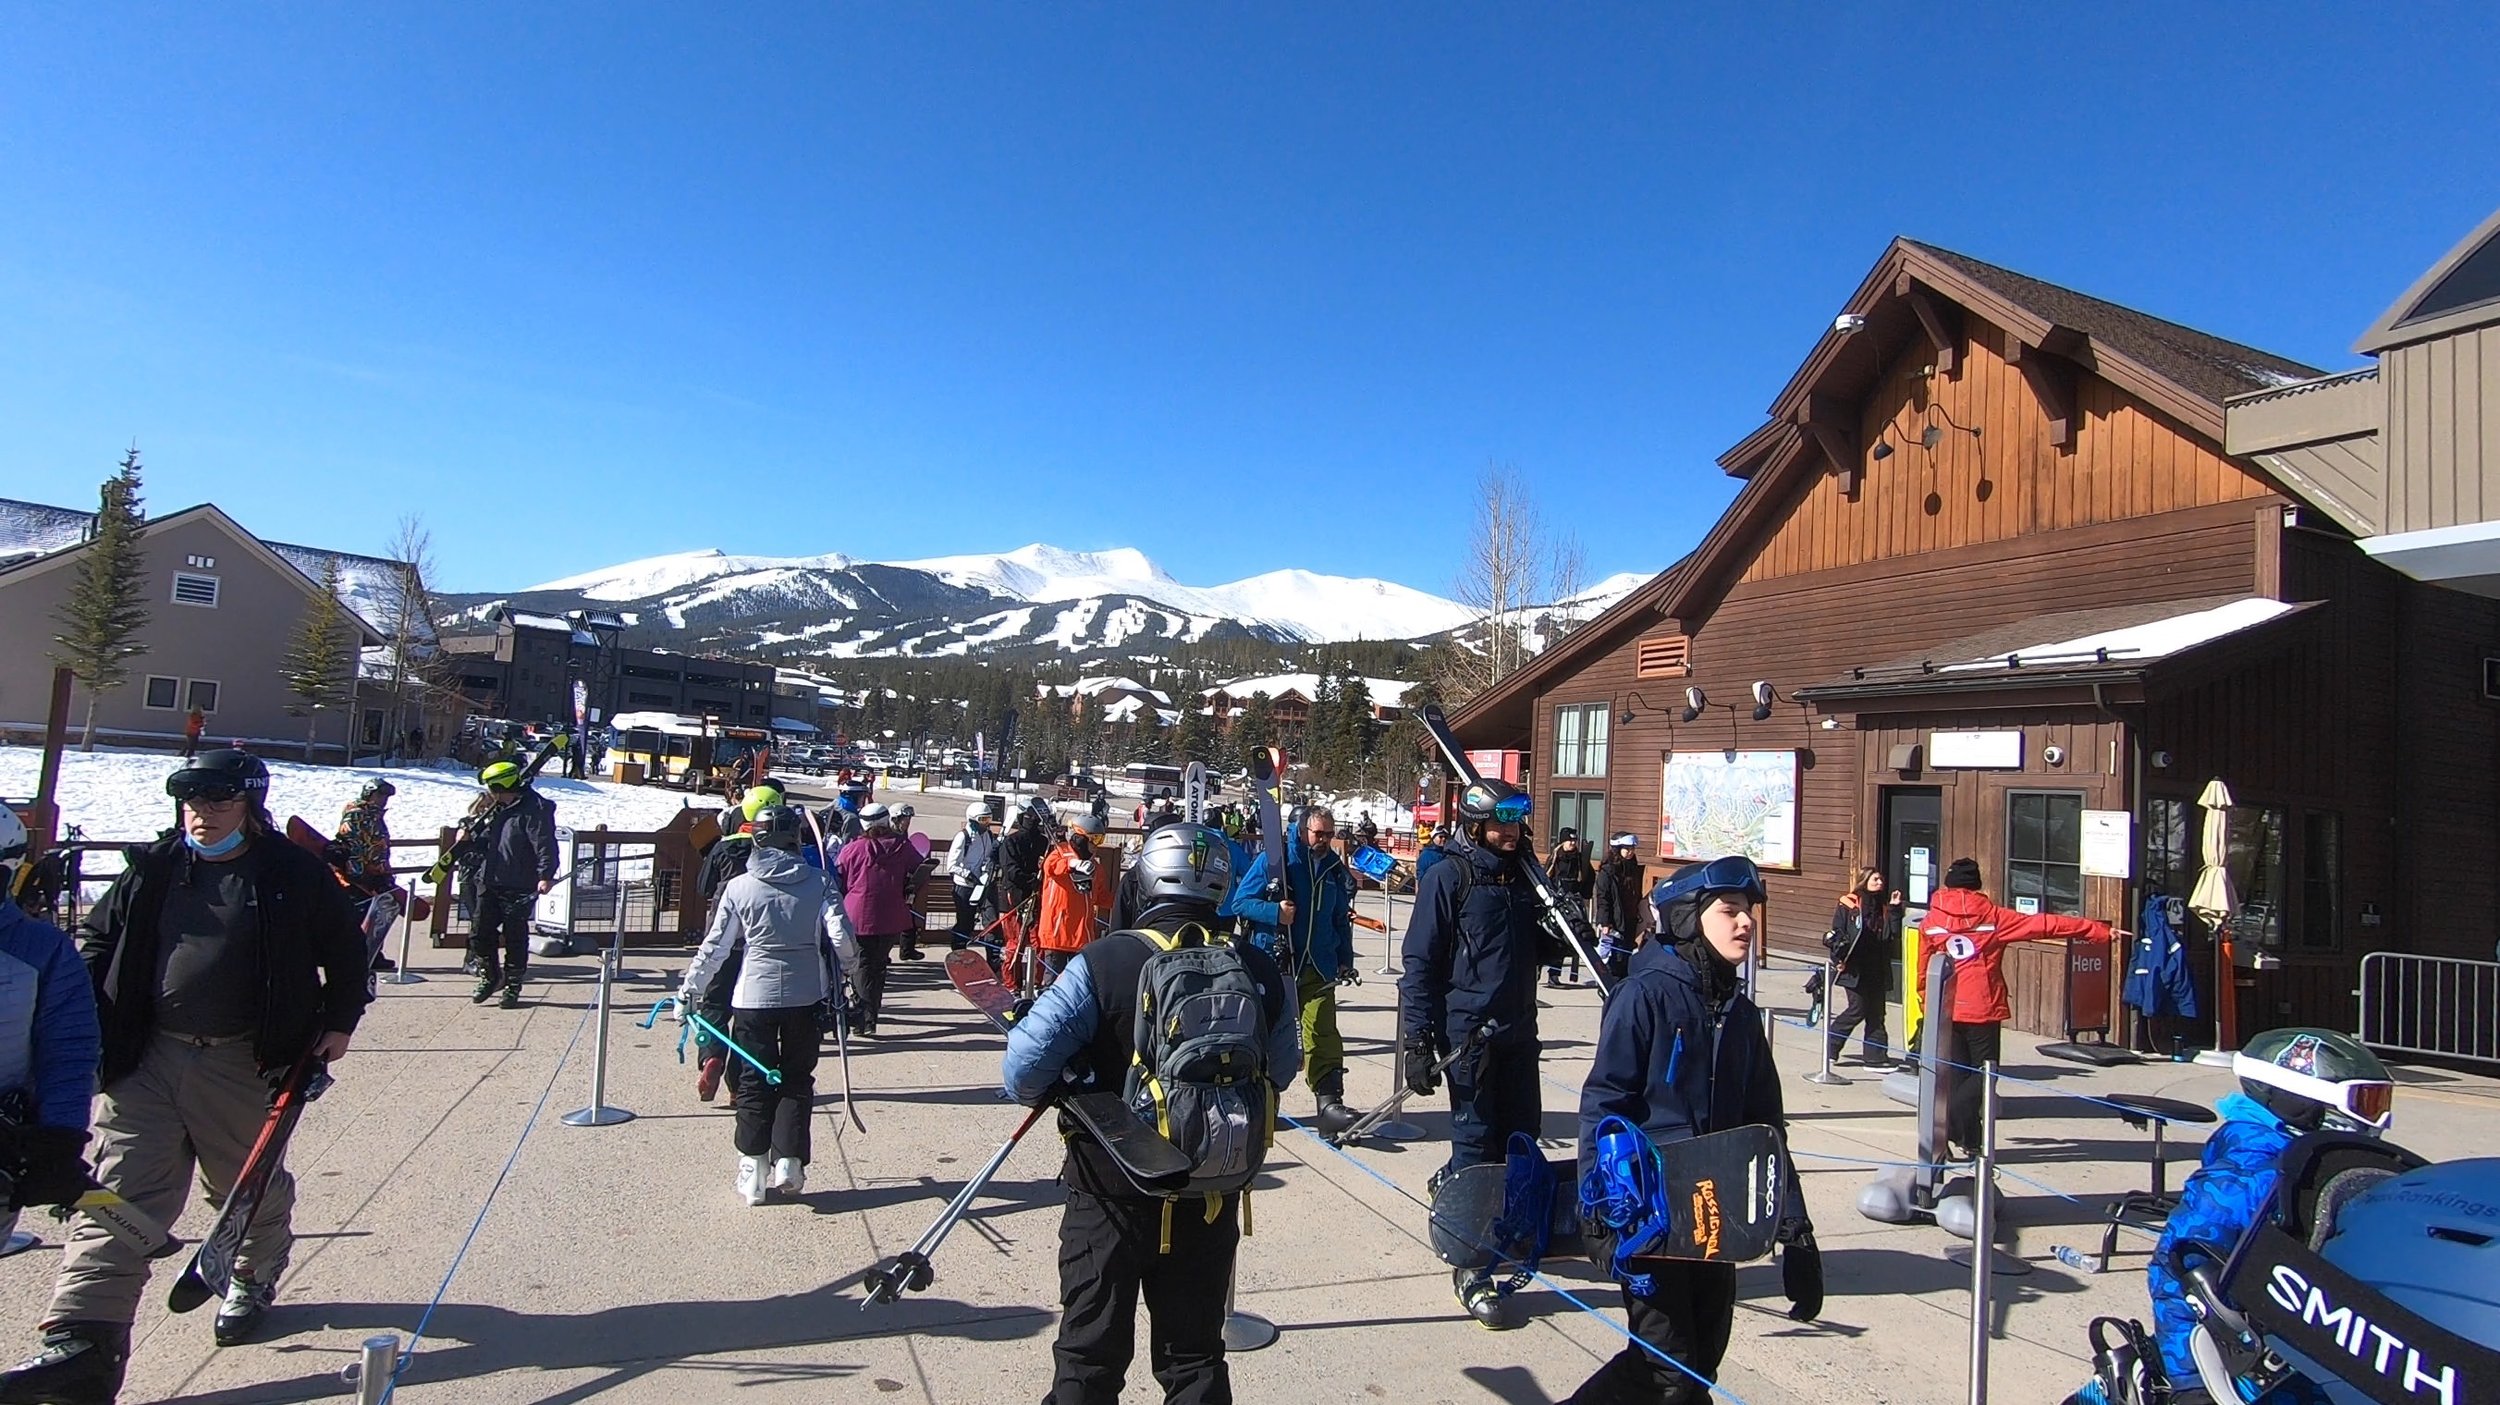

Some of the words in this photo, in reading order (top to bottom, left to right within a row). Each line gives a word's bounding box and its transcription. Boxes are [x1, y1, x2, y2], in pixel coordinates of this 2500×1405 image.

[549, 900, 556, 915] 8
[2071, 954, 2102, 972] Here
[2266, 1265, 2455, 1405] SMITH
